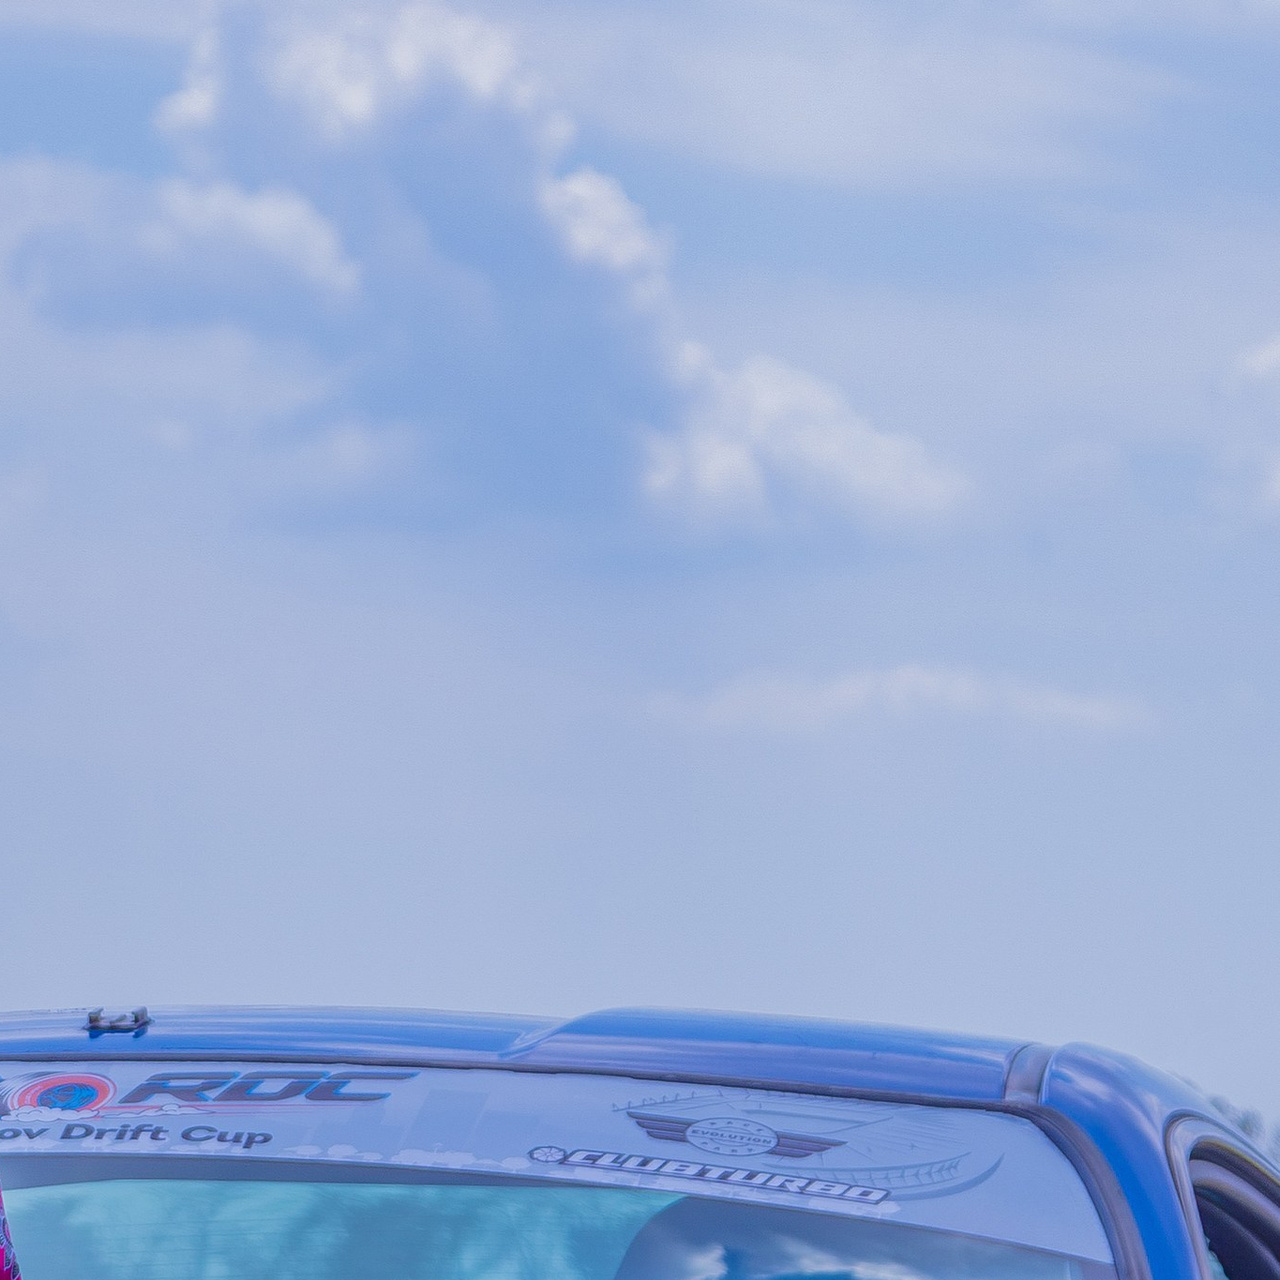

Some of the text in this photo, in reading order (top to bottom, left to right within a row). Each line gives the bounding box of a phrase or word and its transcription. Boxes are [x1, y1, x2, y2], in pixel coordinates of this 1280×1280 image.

[118, 1070, 419, 1104] RDC
[60, 1123, 169, 1143] Drift
[181, 1125, 273, 1149] Cup
[691, 1128, 773, 1147] EVOLUTION
[565, 1148, 888, 1204] CLUBTURBO
